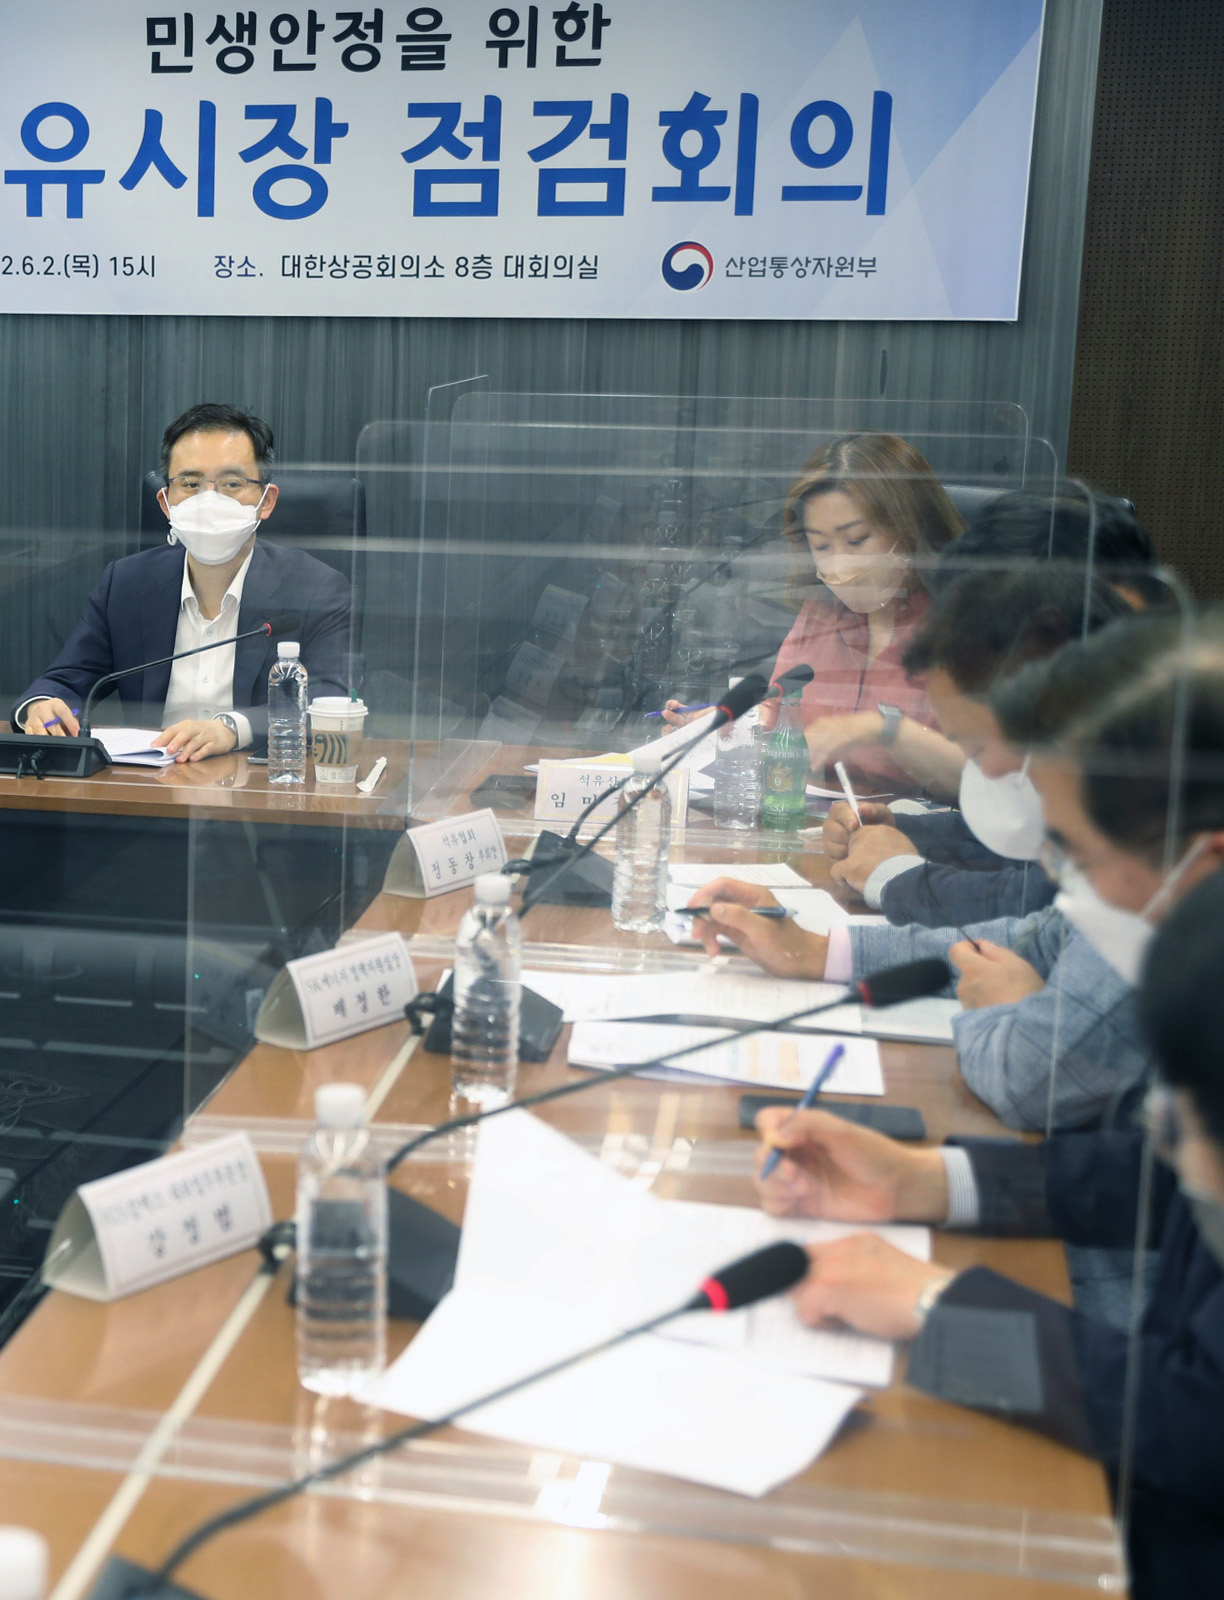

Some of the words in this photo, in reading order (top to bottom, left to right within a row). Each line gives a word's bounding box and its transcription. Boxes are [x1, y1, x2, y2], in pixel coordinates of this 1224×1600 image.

[146, 7, 452, 75] 민생안정을
[485, 1, 612, 69] 위한
[399, 90, 894, 218] 점검회의
[109, 253, 156, 278] 15시
[213, 254, 264, 278] 장소.
[280, 254, 445, 279] 대한상공회의소
[455, 255, 493, 279] 8층
[504, 255, 600, 280] 대회의실
[725, 255, 878, 279] 산업통상자원부
[441, 828, 476, 849] 석유협회
